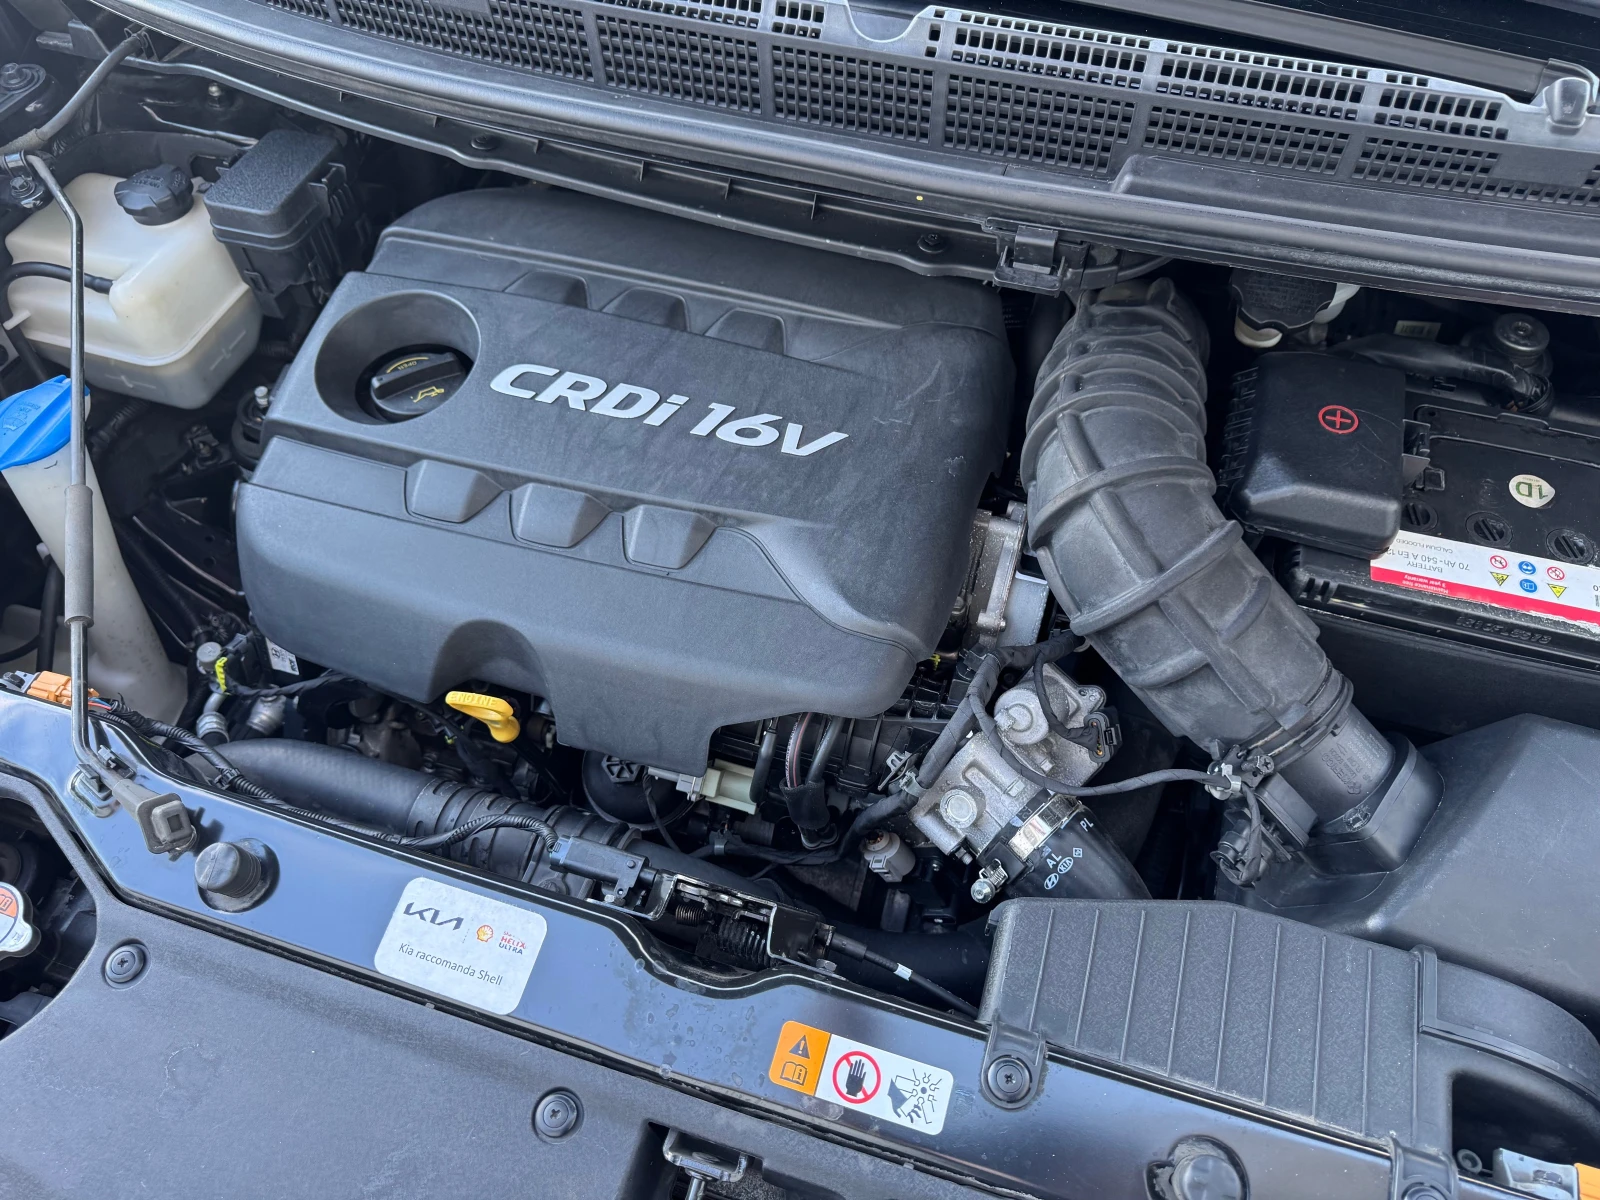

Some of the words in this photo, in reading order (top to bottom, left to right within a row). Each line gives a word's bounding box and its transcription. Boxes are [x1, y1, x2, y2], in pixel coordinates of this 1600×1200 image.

[490, 363, 690, 427] CRDi
[690, 402, 849, 457] 16V
[1397, 550, 1409, 559] En
[1411, 552, 1419, 560] A
[1425, 544, 1454, 554] CALCIUM
[1406, 560, 1443, 574] BATTERY
[1458, 562, 1470, 571] 70
[1404, 574, 1429, 584] warranty
[1414, 582, 1449, 595] Maintenance
[449, 692, 497, 707] ENGINE
[1080, 817, 1094, 832] PL
[1046, 853, 1062, 869] AL
[1058, 858, 1073, 872] KIA
[403, 902, 465, 931] KIA
[498, 942, 523, 955] ULTRA
[500, 935, 526, 949] HELIX
[398, 942, 414, 956] Kia
[415, 949, 477, 978] raccomanda
[477, 968, 503, 986] Shell
